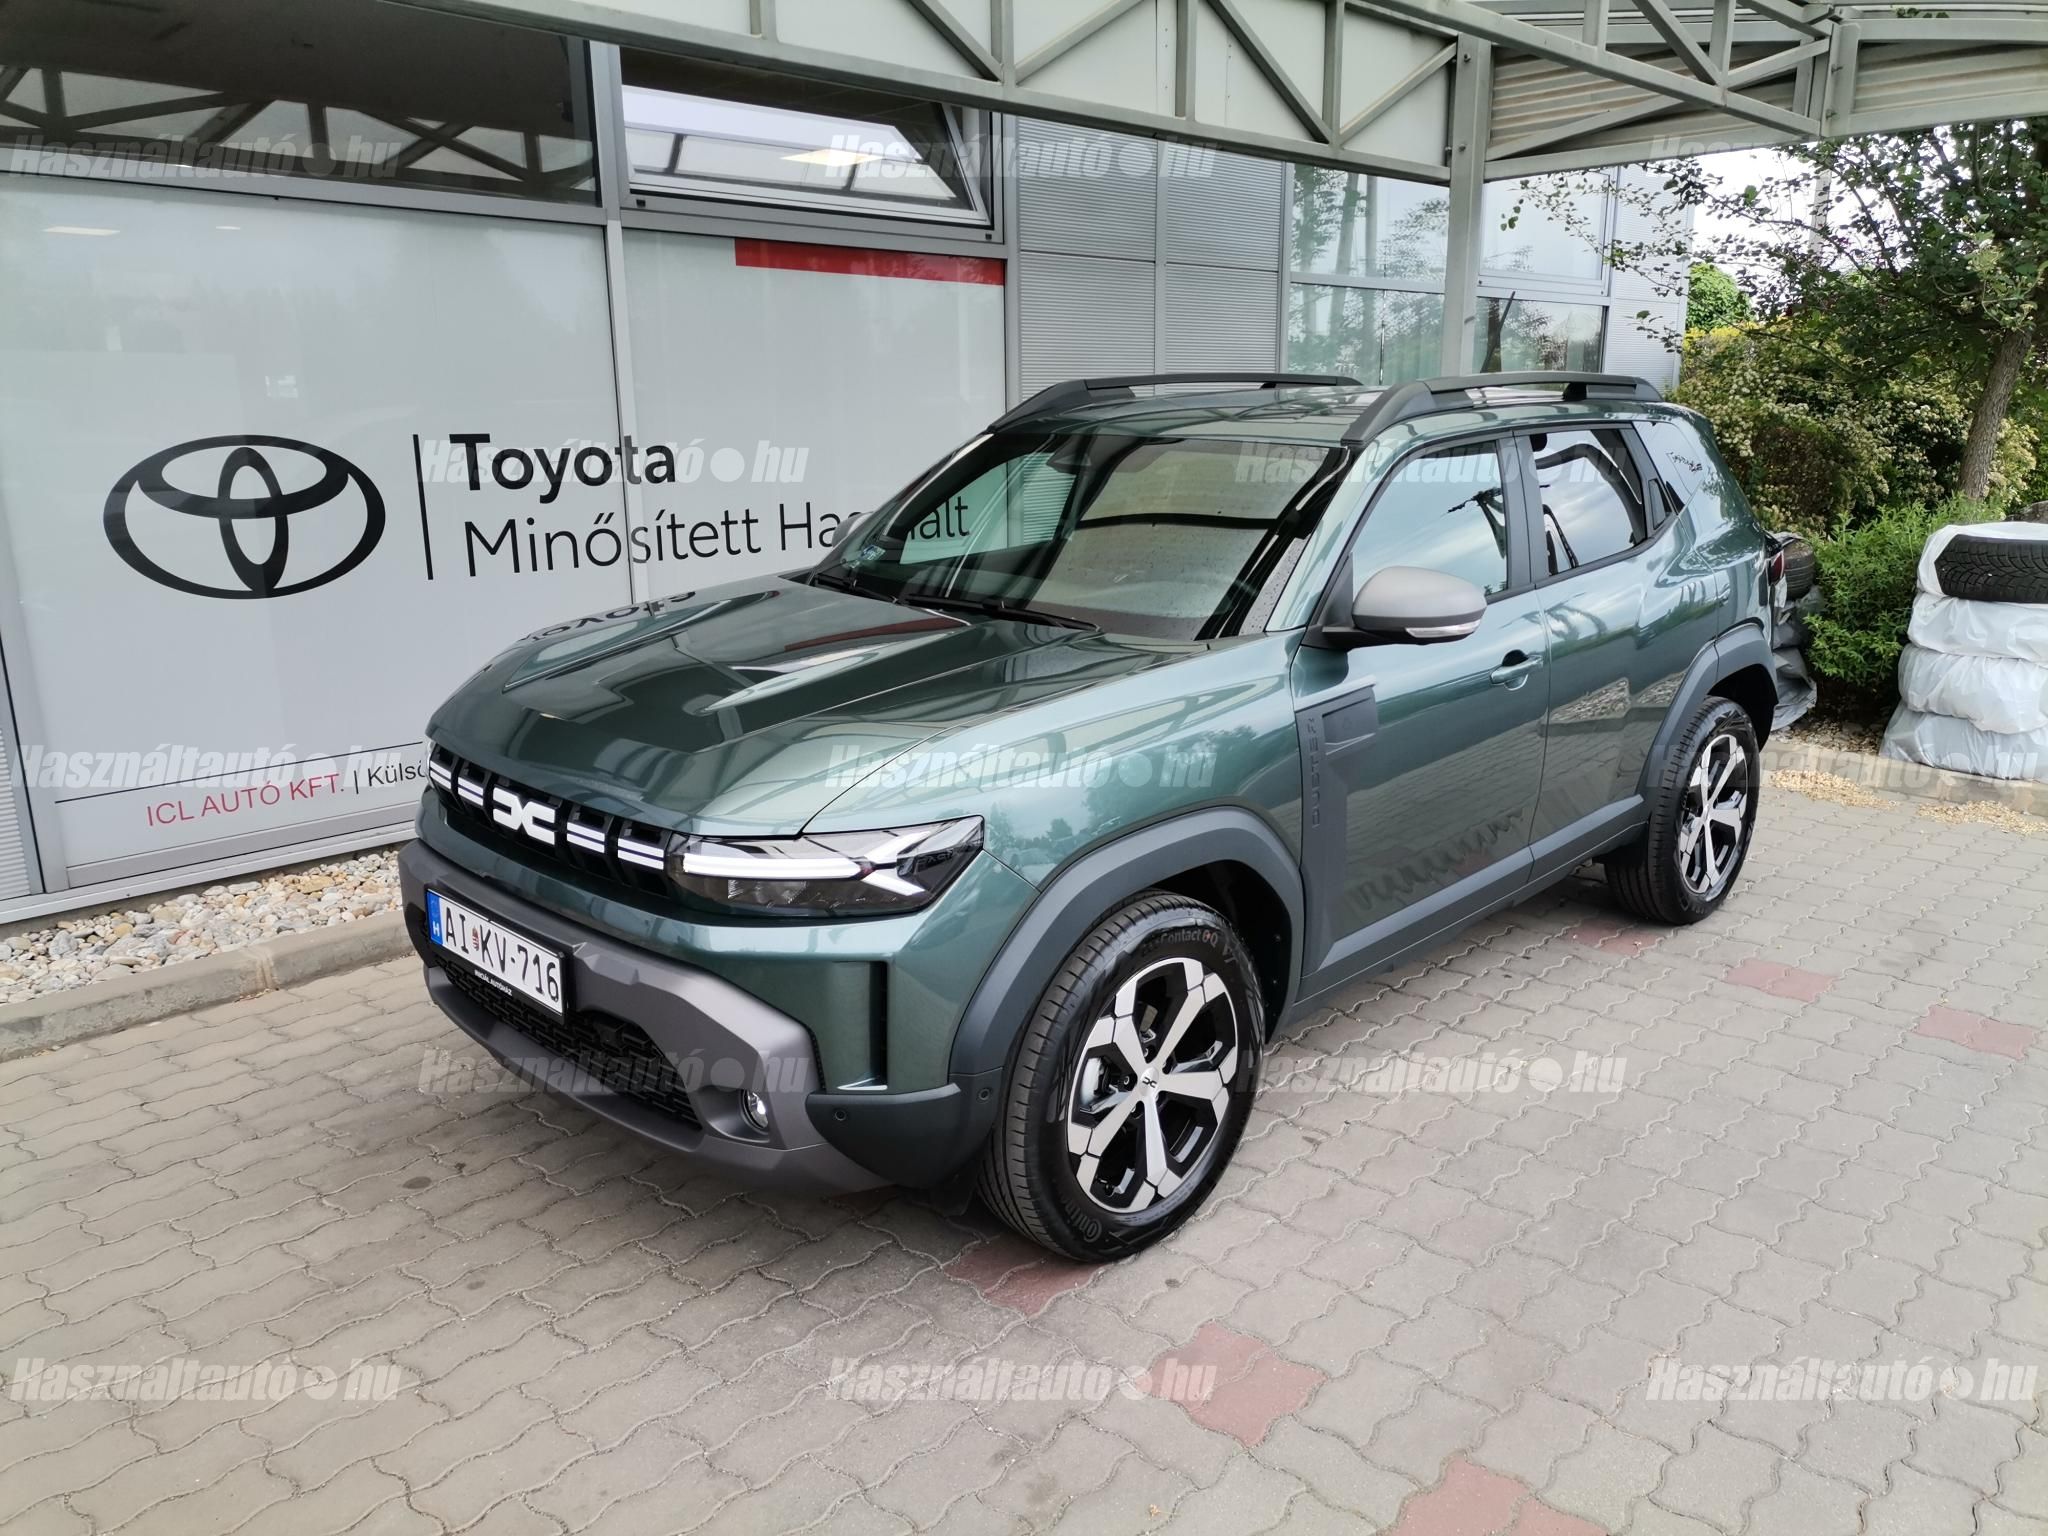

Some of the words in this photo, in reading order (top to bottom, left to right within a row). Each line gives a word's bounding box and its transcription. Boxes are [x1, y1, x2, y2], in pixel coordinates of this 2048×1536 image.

[449, 433, 676, 504] Toyota
[464, 508, 762, 577] Minősített
[146, 800, 194, 827] ICL
[201, 782, 281, 817] AUTÓ
[289, 773, 345, 801] KFT.
